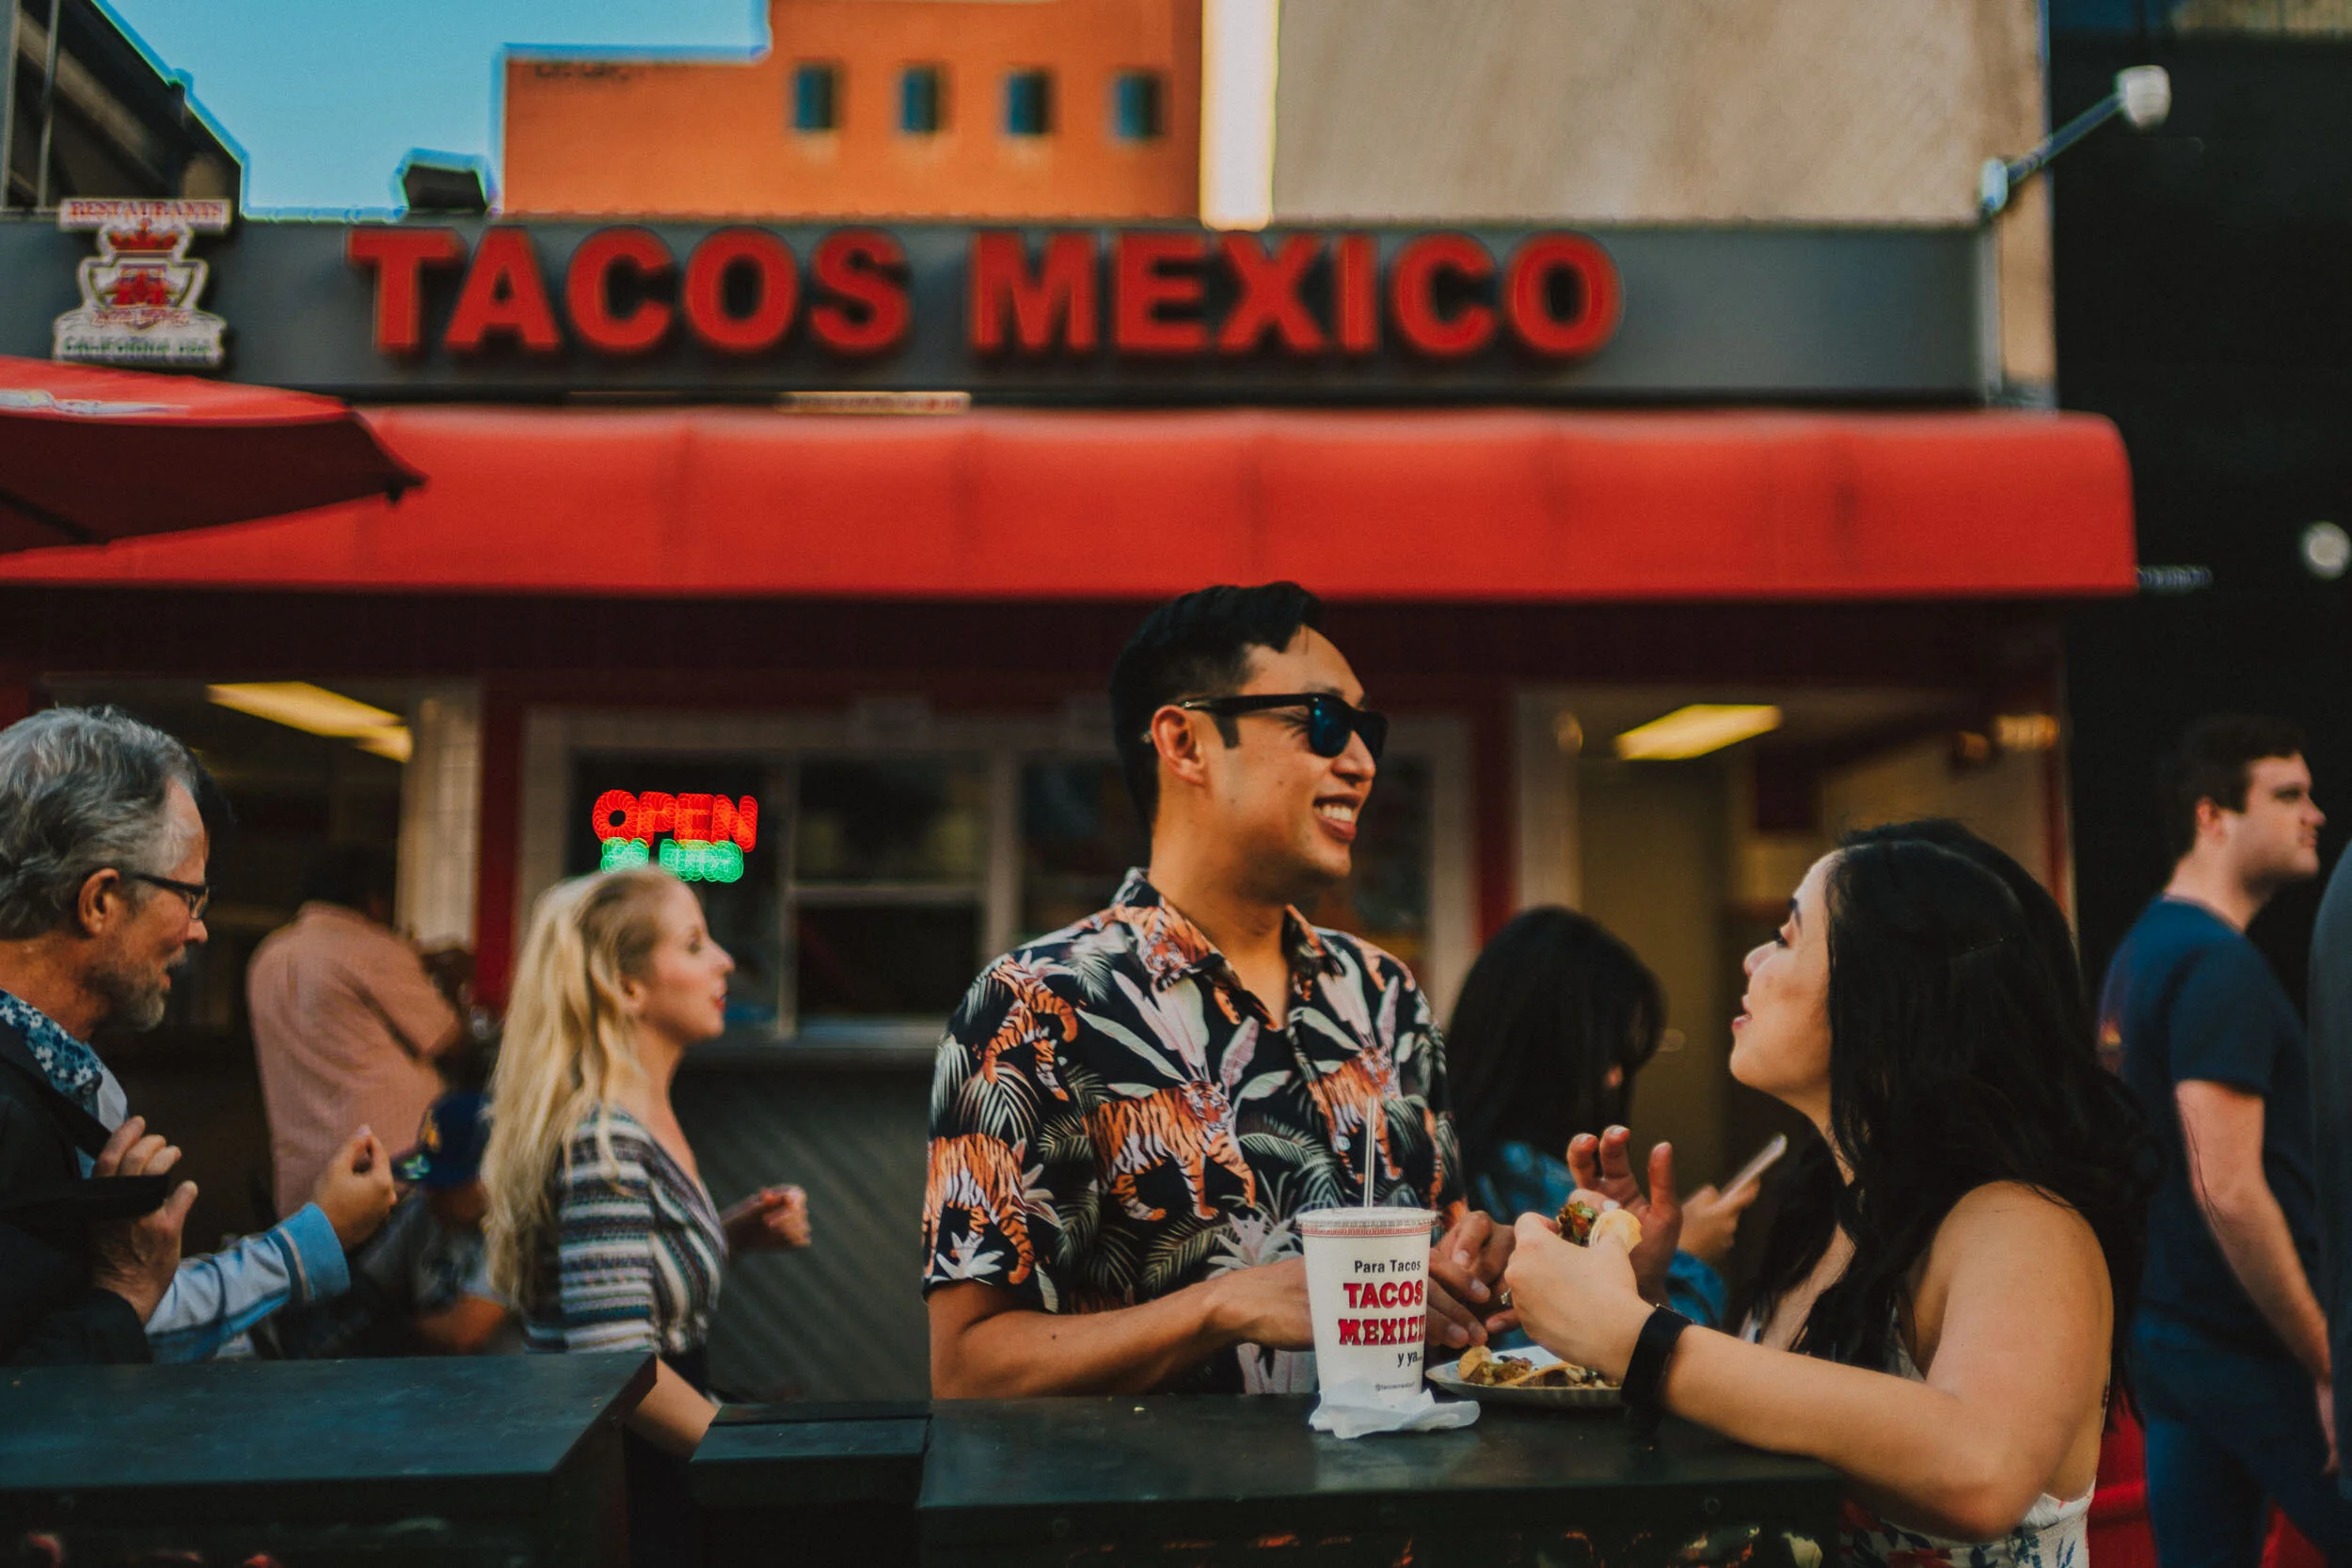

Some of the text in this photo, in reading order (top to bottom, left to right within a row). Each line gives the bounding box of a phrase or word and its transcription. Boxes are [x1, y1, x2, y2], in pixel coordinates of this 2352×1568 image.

[346, 227, 1622, 356] TACOS MEXICO
[593, 789, 758, 852] OPEN
[1355, 1259, 1421, 1274] Para Tacos
[1343, 1279, 1423, 1309] TACOS
[1397, 1352, 1405, 1369] y
